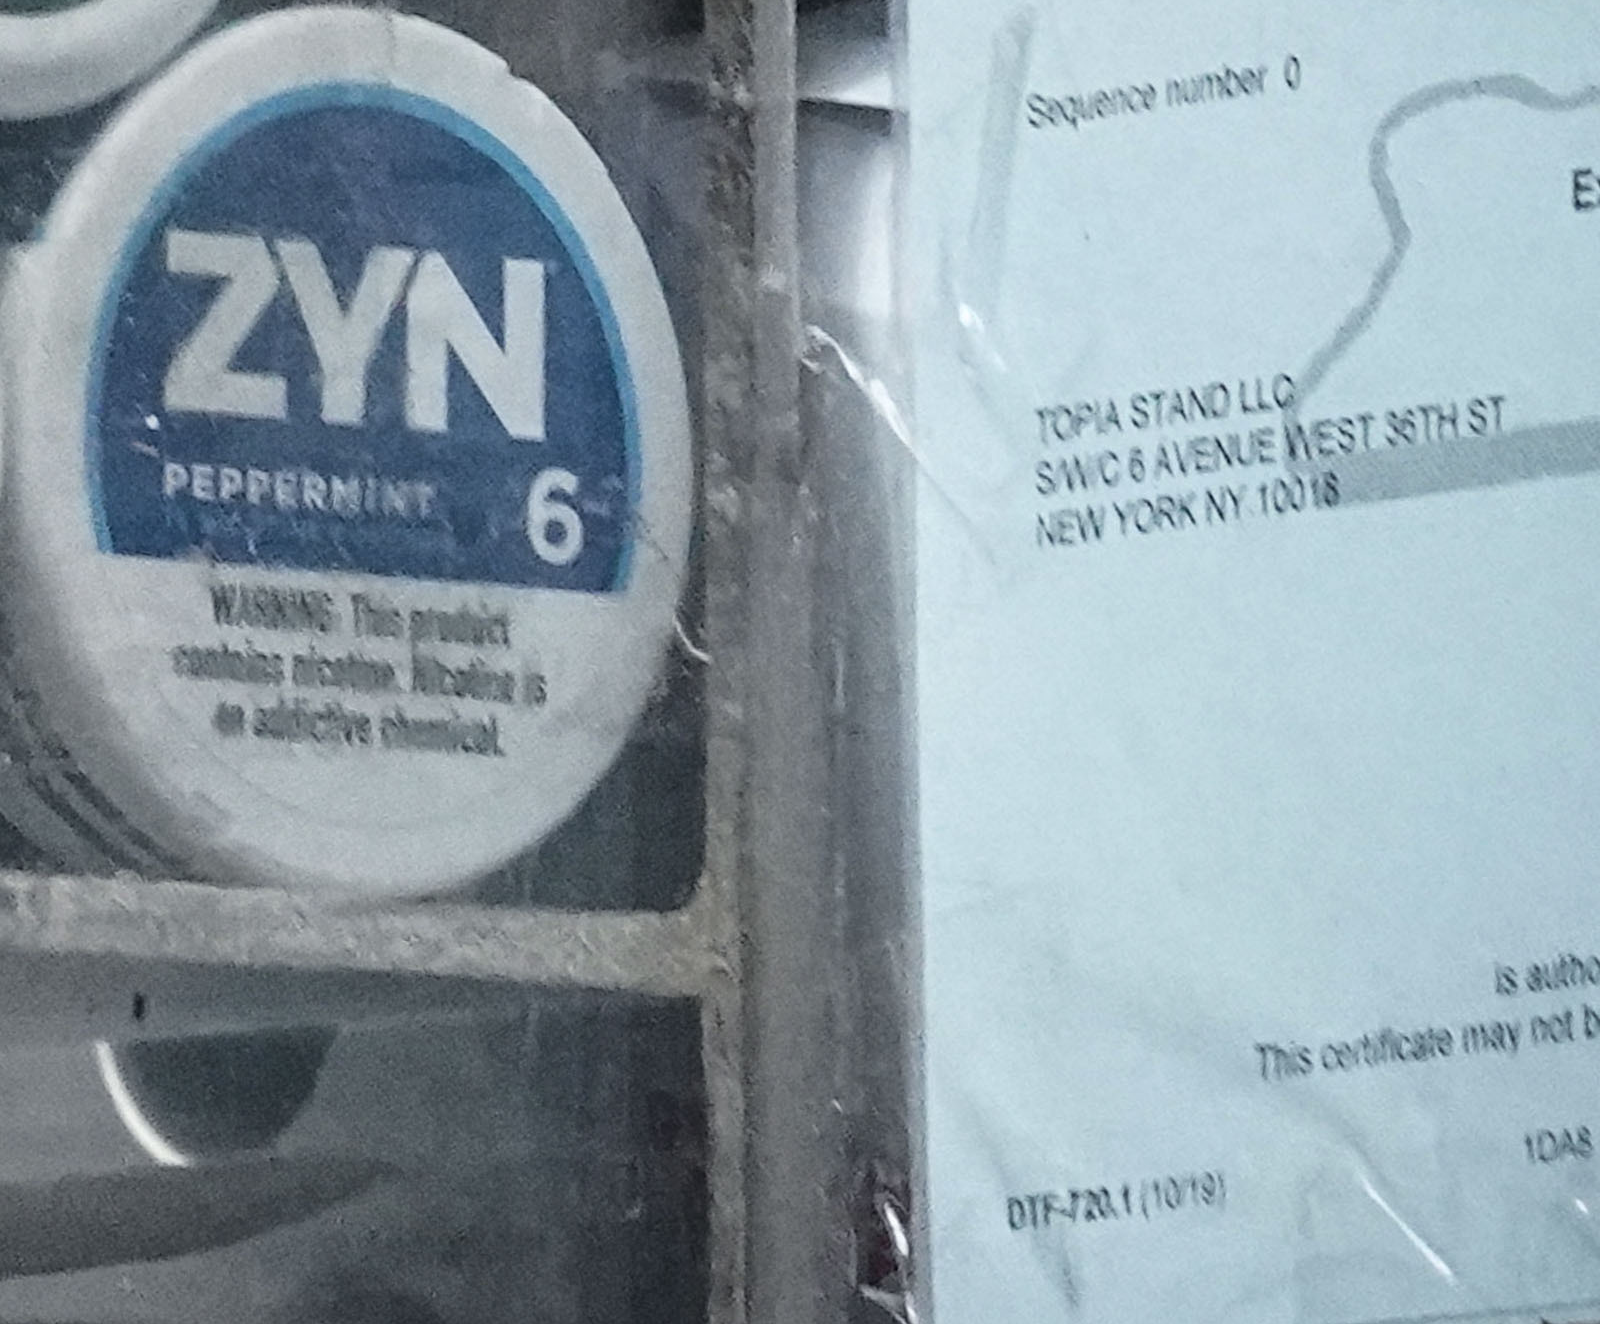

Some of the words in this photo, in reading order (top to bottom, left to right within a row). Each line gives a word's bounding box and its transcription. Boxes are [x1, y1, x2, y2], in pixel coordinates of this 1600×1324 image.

[1026, 81, 1158, 132] Sequence
[1166, 64, 1267, 108] number
[1283, 54, 1302, 91] 0
[163, 226, 555, 442] ZYN
[1035, 399, 1122, 445] TOPIA
[1131, 385, 1233, 433] STAND
[1239, 372, 1298, 413] LLC
[1129, 450, 1149, 486] 6
[1156, 430, 1278, 478] AVENUE
[1284, 413, 1375, 461] WEST
[1382, 402, 1461, 450] 36TH
[1468, 394, 1507, 436] ST
[164, 461, 437, 519] PEPPERMINT
[524, 467, 584, 566] 6
[1036, 503, 1107, 548] NEW
[1115, 489, 1197, 538] YORK
[1204, 485, 1243, 524] NY
[1494, 961, 1518, 993] is
